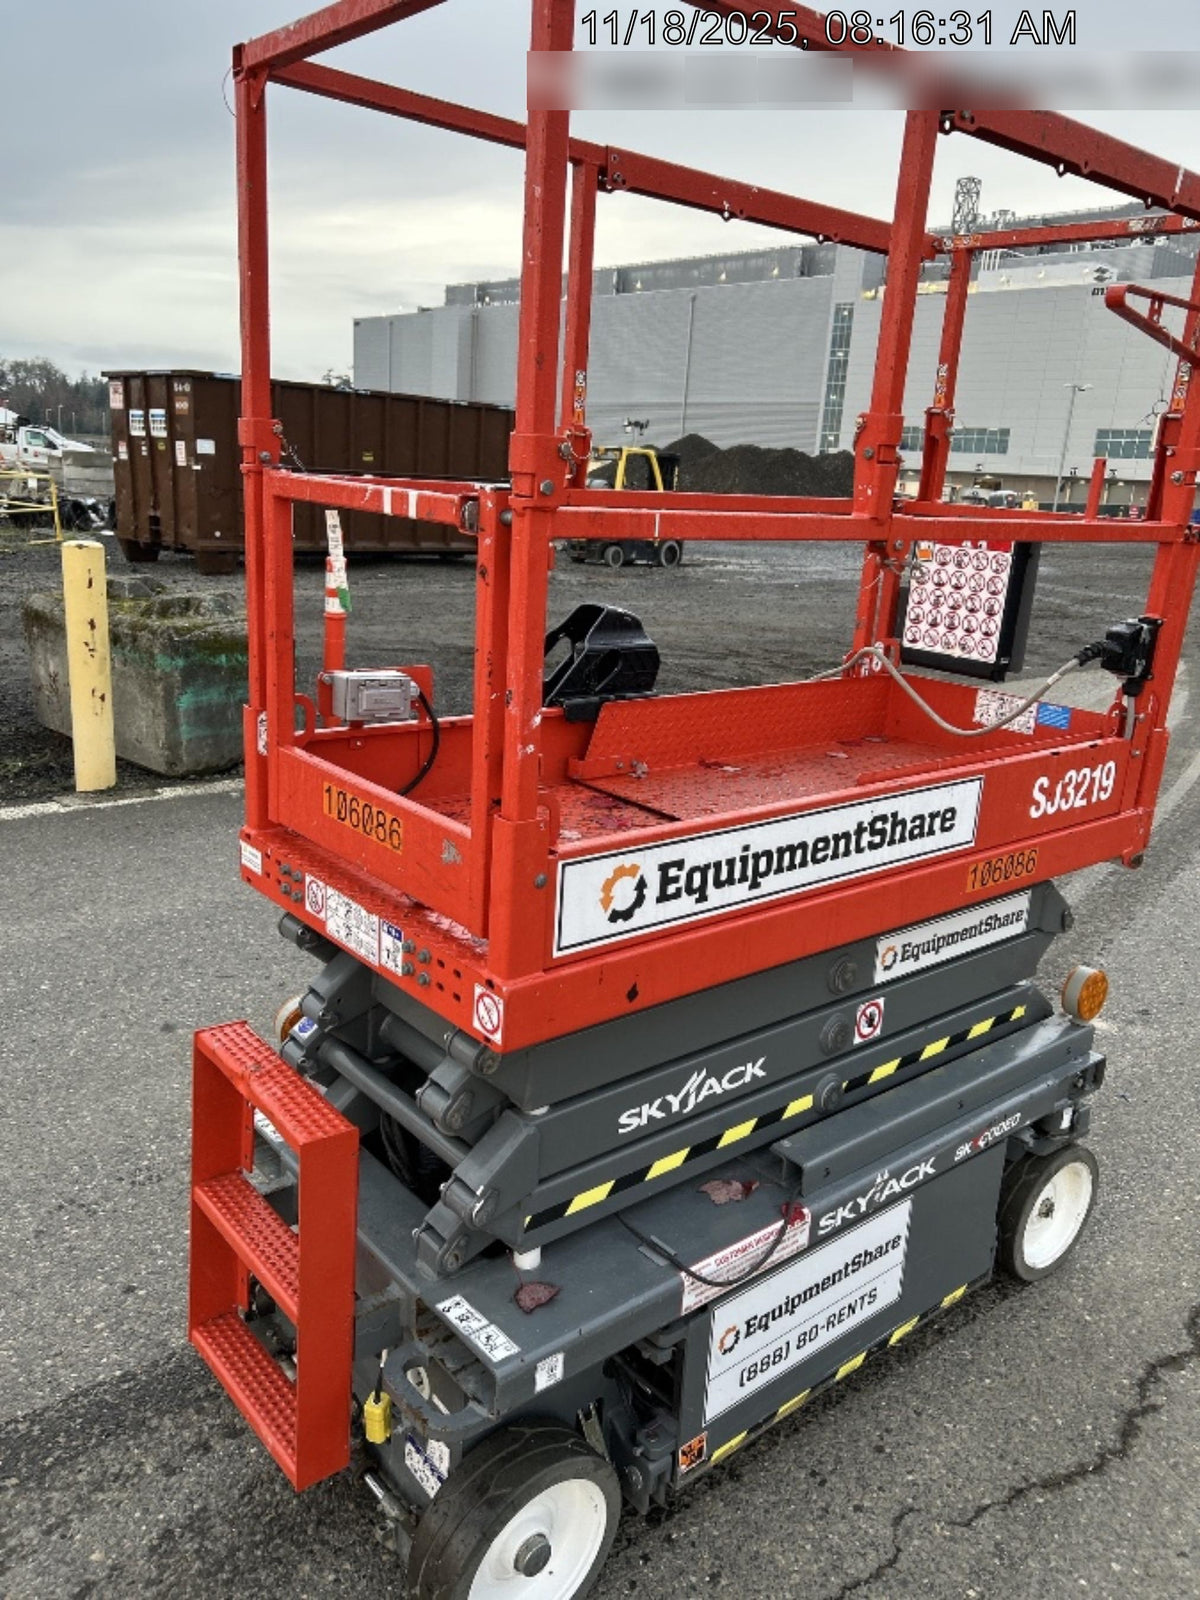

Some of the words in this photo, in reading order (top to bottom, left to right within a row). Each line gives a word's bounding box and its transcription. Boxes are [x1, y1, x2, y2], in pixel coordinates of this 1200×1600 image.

[325, 785, 401, 850] 106086
[1029, 760, 1116, 819] SJ3219
[656, 806, 956, 903] EquipmentShare
[970, 849, 1038, 890] 106086
[899, 909, 1025, 963] EquipmentShare
[618, 1056, 767, 1134] SKYJACK
[744, 1235, 902, 1339] EquipmentShare
[739, 1342, 790, 1387] (888)
[796, 1287, 878, 1351] 80-RENTS
